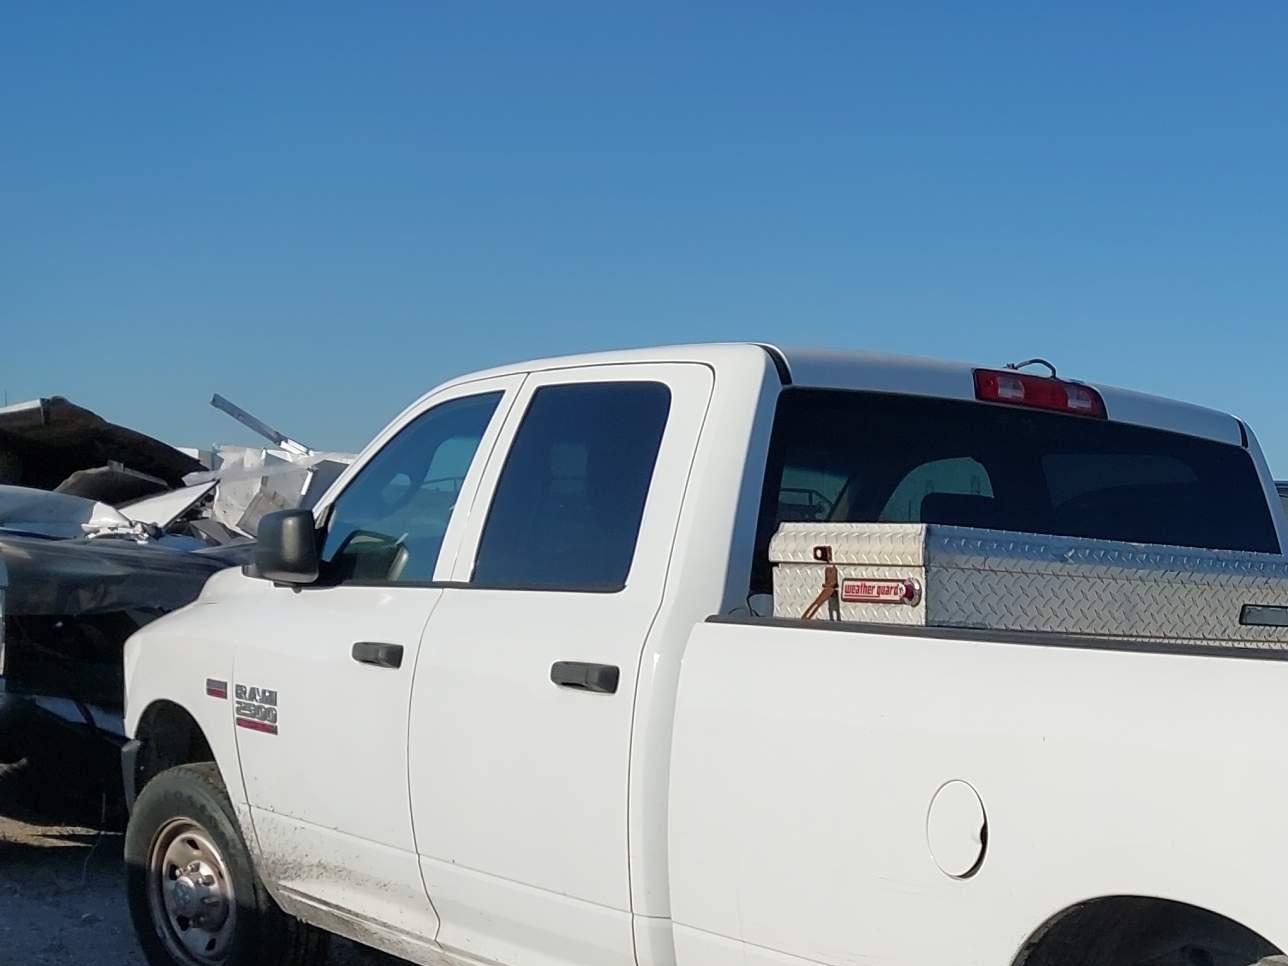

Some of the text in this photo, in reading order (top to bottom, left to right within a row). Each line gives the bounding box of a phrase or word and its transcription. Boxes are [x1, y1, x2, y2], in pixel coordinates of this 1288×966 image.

[844, 583, 899, 597] weather guard
[235, 683, 278, 707] RAM
